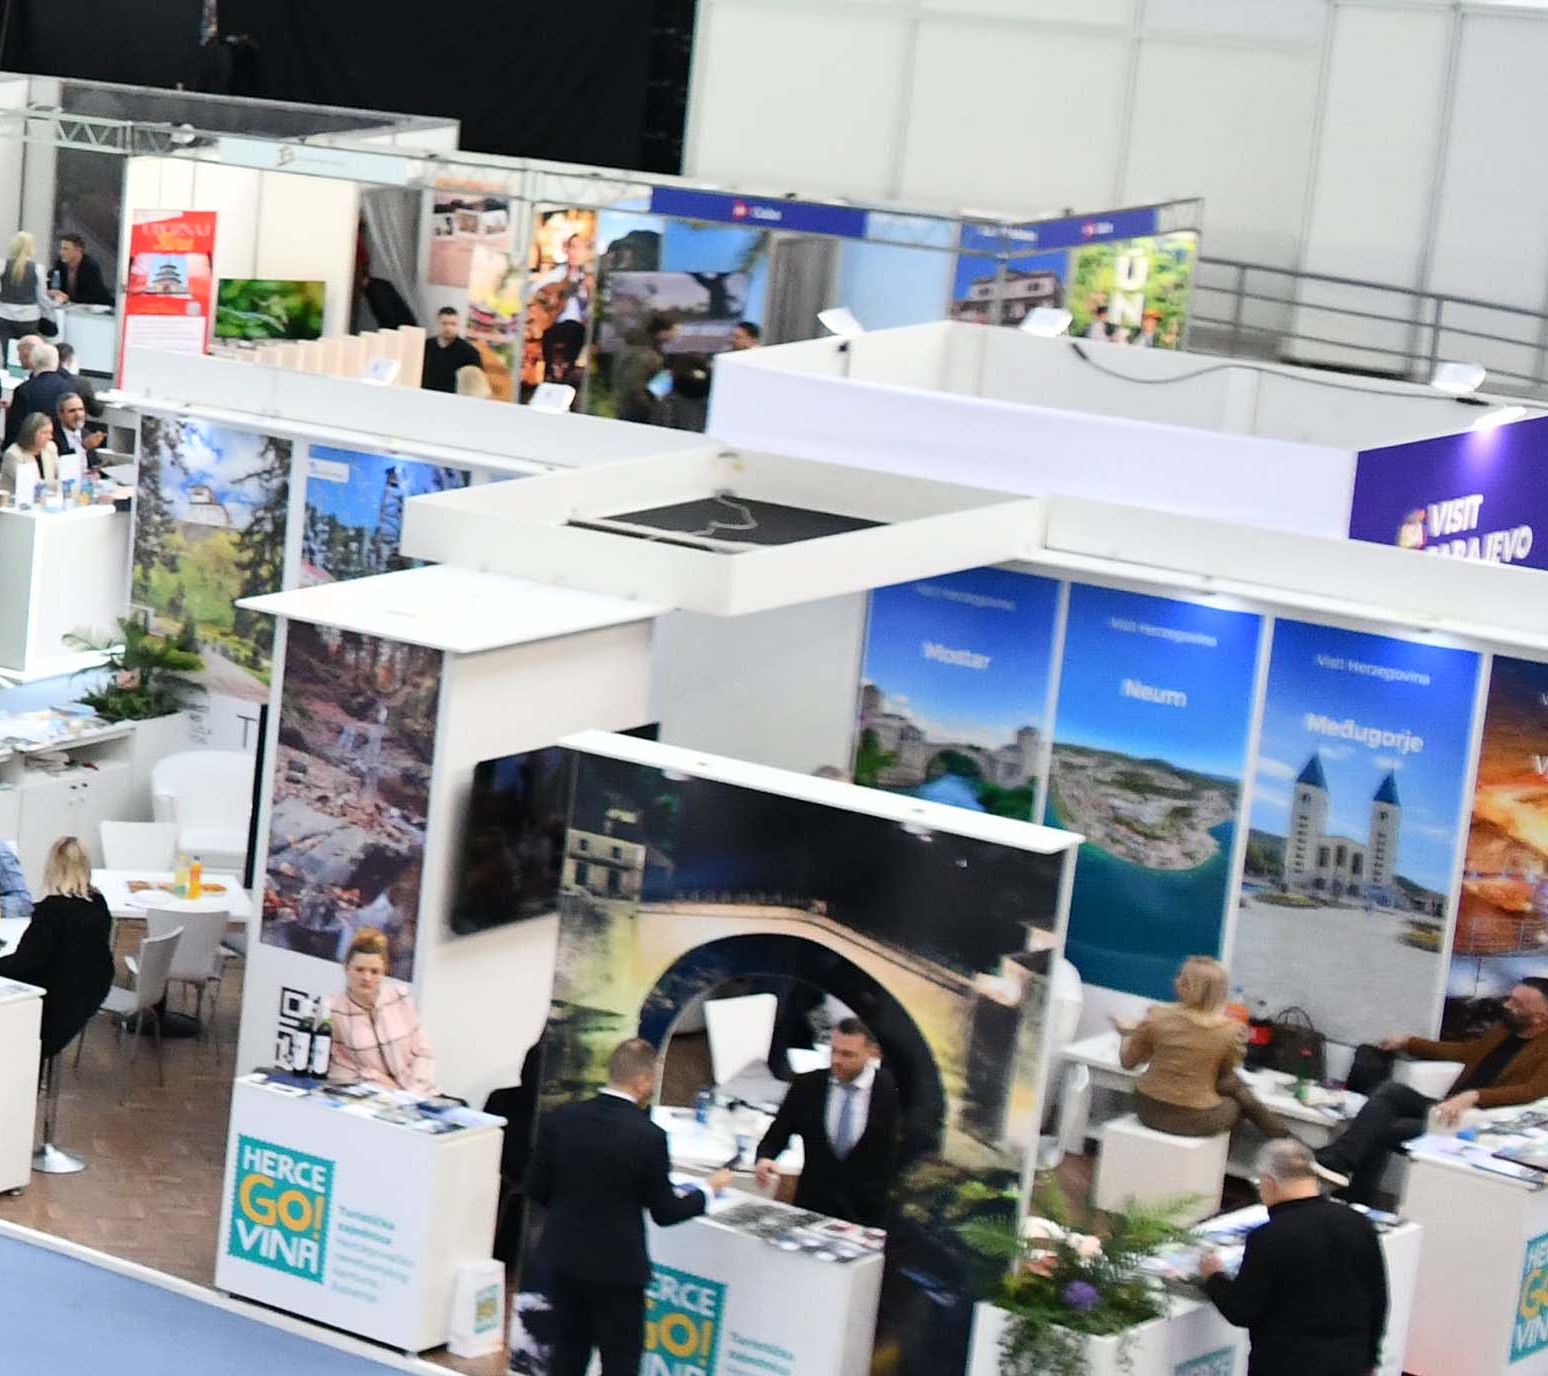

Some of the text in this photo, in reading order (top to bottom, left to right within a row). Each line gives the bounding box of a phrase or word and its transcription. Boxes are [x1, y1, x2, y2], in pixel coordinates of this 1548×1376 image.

[1427, 493, 1484, 538] VISIT
[1139, 623, 1218, 646] Herzegovina
[922, 642, 992, 670] Mostar
[1347, 660, 1431, 686] Herzegovina
[1122, 678, 1188, 708] Neum
[1304, 712, 1424, 754] Međugorje
[242, 1143, 328, 1194] HERCE
[239, 1172, 326, 1241] GO!
[235, 1218, 321, 1274] VINA
